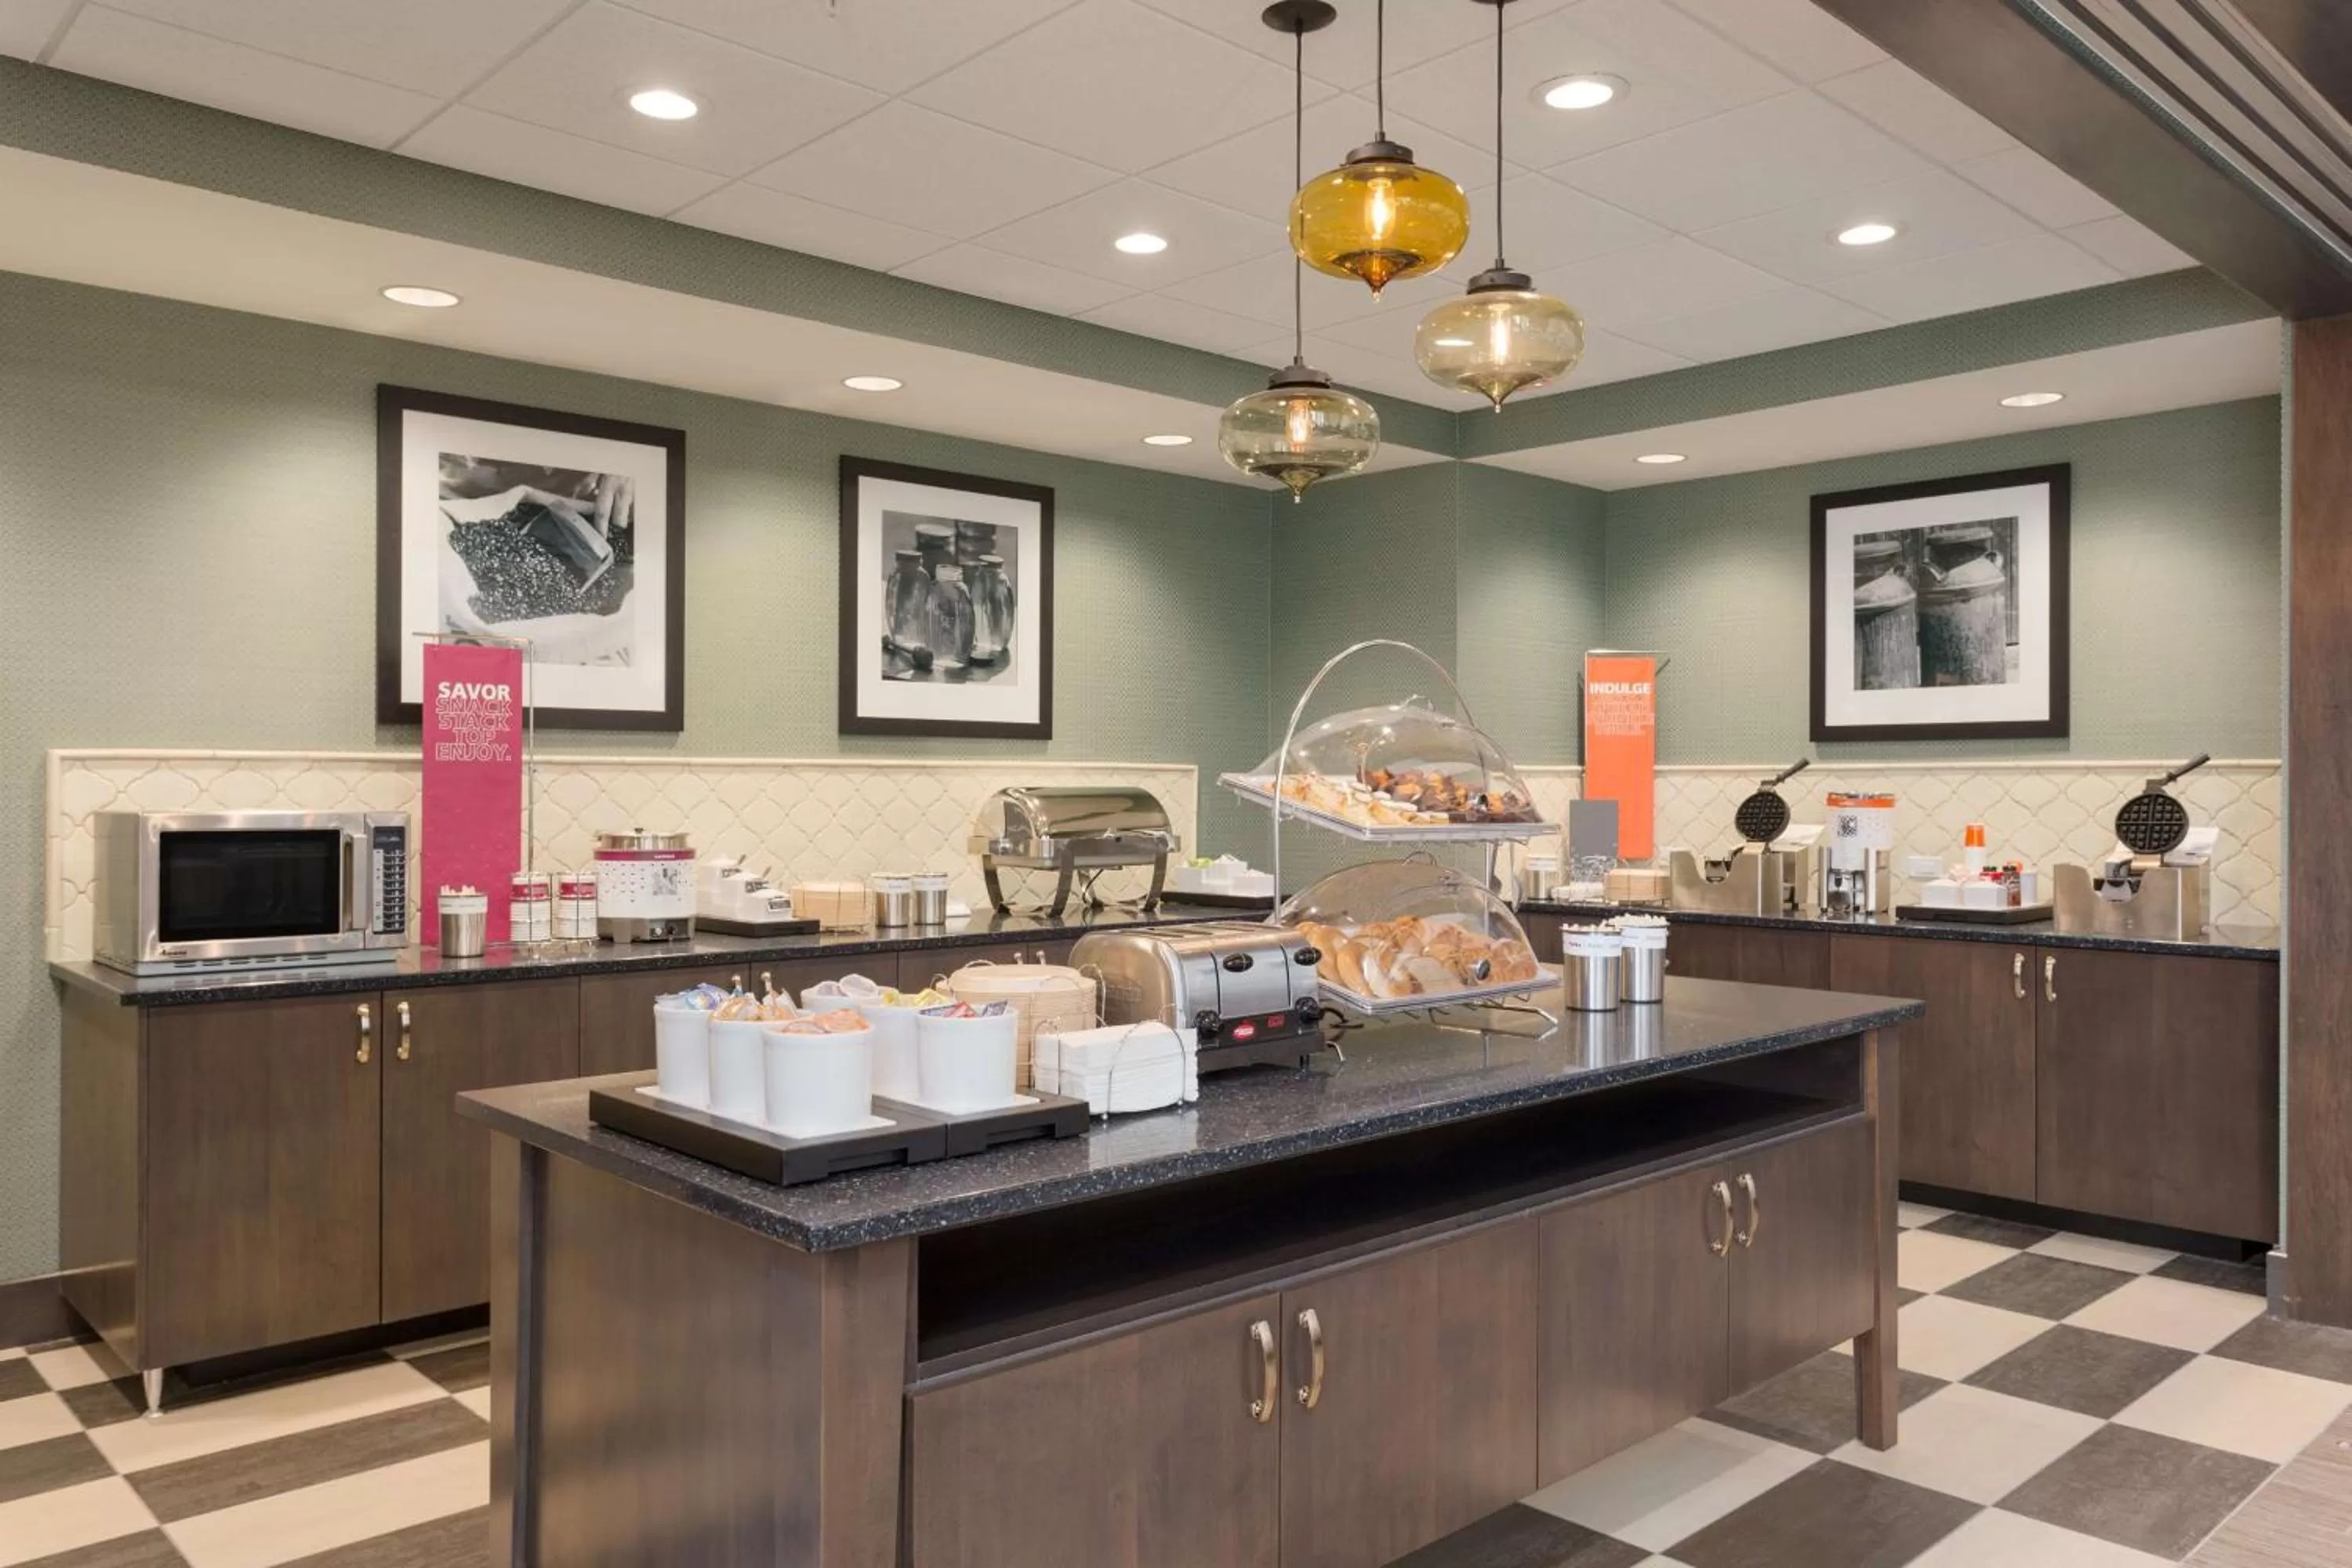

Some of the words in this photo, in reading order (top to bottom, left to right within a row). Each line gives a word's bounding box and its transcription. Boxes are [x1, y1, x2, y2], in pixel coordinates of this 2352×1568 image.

[438, 681, 511, 700] SAVOR
[1590, 681, 1650, 694] INDULGE
[436, 698, 512, 715] SNACK
[439, 713, 510, 731] STACK
[452, 728, 496, 744] TOP
